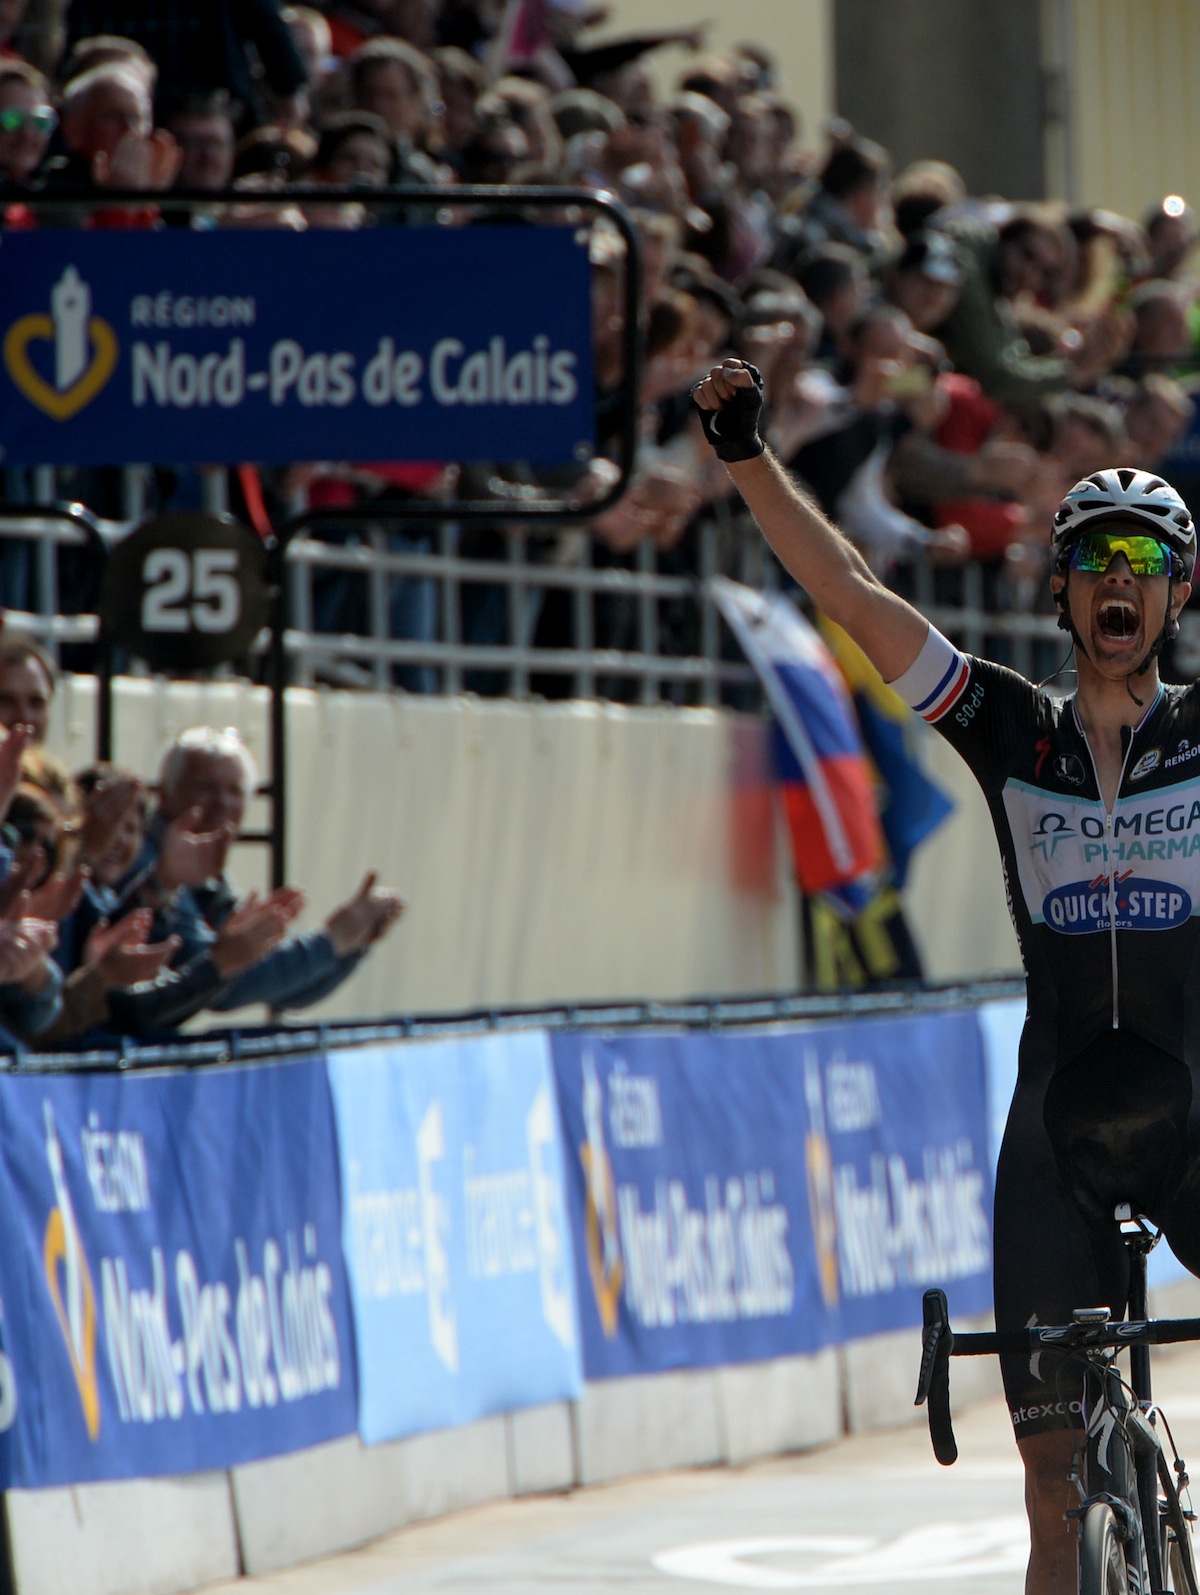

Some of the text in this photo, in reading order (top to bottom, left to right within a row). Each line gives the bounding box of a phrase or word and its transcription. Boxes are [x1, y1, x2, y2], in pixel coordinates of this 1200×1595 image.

[131, 291, 256, 328] RÉGION
[131, 334, 579, 408] Nord-Pas de Calais
[141, 548, 241, 632] 25
[1013, 1401, 1082, 1424] atexco
